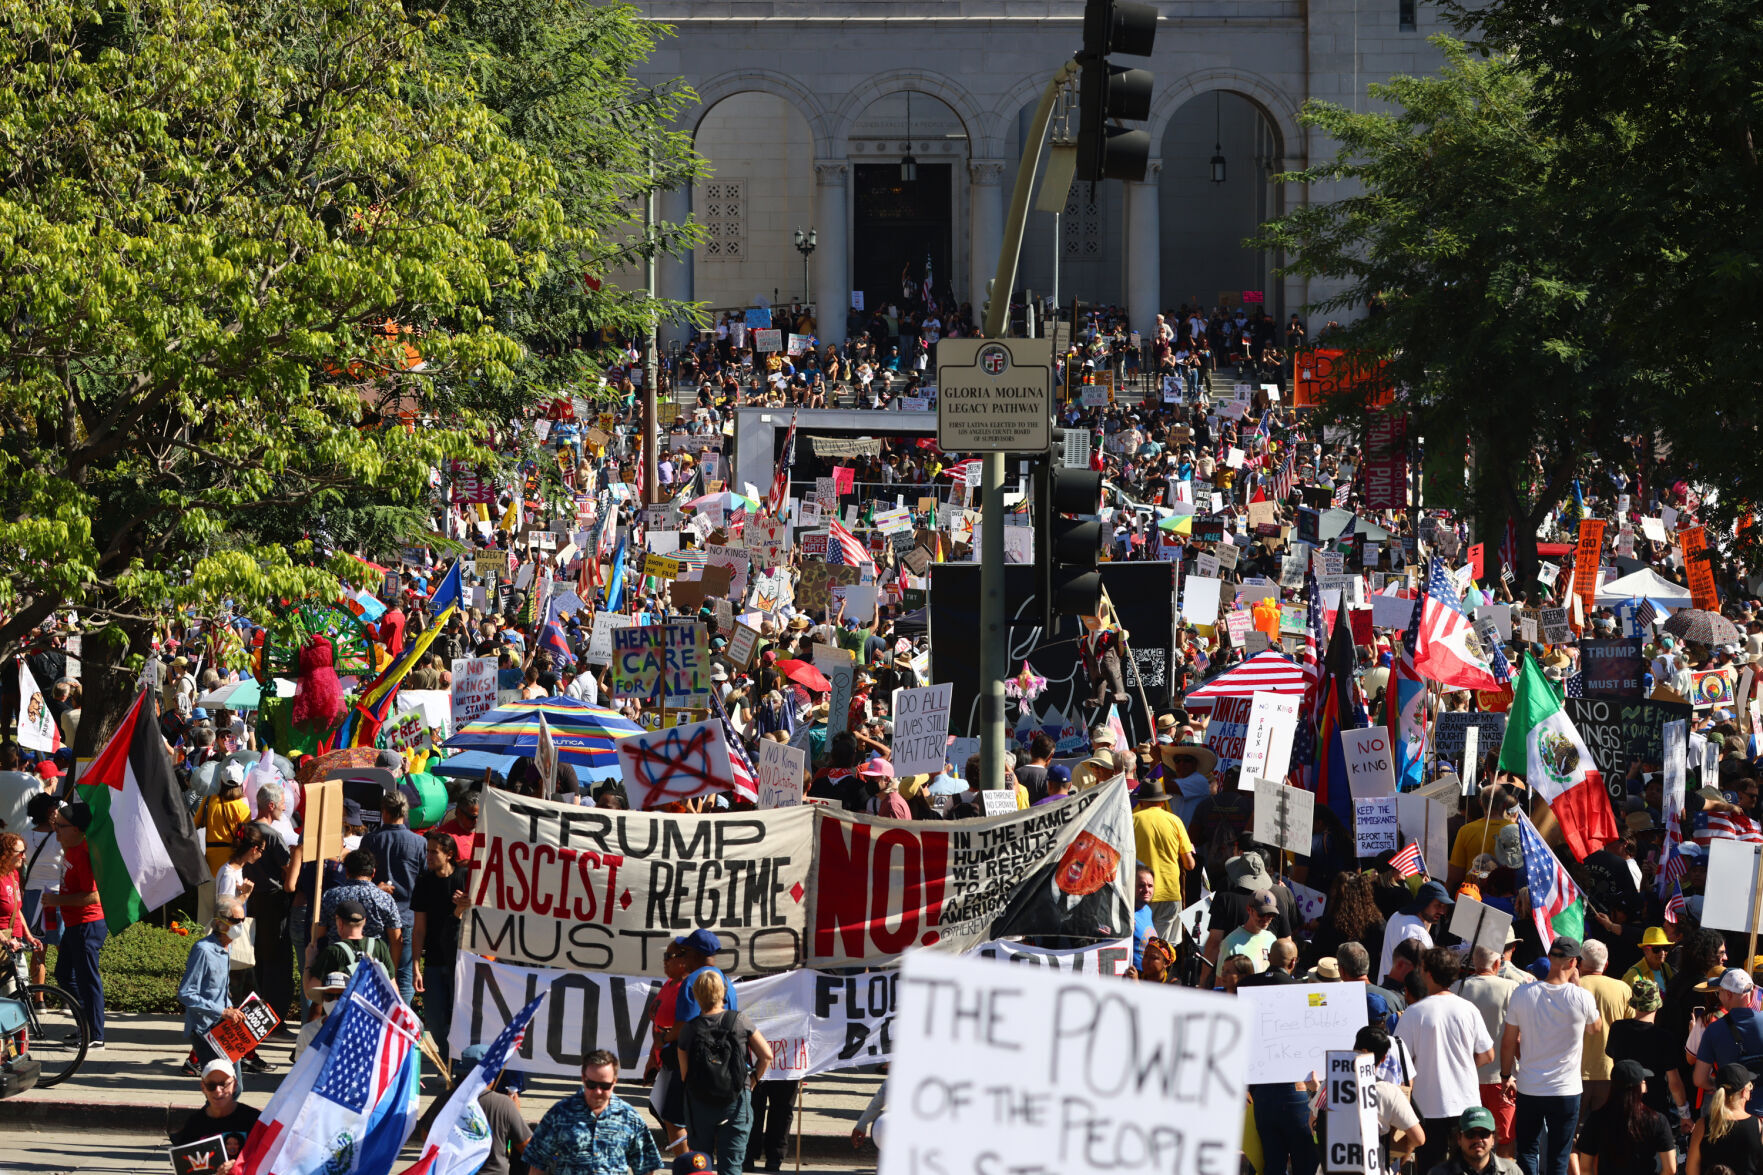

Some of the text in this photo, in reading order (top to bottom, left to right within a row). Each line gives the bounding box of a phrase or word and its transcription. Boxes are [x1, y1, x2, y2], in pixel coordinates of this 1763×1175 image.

[944, 387, 1043, 398] GLORIA MOLINA
[948, 403, 1040, 414] LEGACY PATHWAY
[1369, 467, 1391, 506] PARK
[579, 502, 590, 513] NO
[804, 544, 826, 553] HATE
[1581, 539, 1597, 548] GO
[477, 551, 505, 559] REJECT
[709, 546, 748, 559] NO KINGS
[647, 559, 676, 570] SHOW US
[487, 570, 496, 579] ICE
[661, 570, 677, 578] FILES
[1541, 608, 1566, 620] DEFEND
[614, 625, 695, 650] HEALTH
[1586, 646, 1636, 658] TRUMP
[622, 648, 698, 673] CARE
[467, 661, 484, 676] NO
[615, 671, 709, 697] FOR ALL
[1588, 680, 1638, 688] MUST BE
[456, 692, 497, 706] UNITED WE
[899, 689, 948, 715] DO ALL
[465, 703, 491, 714] STAND
[1575, 699, 1609, 721] NO
[927, 715, 947, 733] STILL
[1444, 713, 1494, 722] BOTH OF MY
[391, 719, 422, 743] FREE
[1219, 722, 1237, 737] ARE
[1435, 732, 1465, 740] FOUGHT
[1574, 721, 1620, 749] INGS
[1357, 738, 1385, 754] NO
[765, 745, 798, 776] NO Kings
[1352, 760, 1388, 774] KING
[1591, 746, 1625, 773] NCE
[759, 765, 798, 790] NO Dictators
[762, 787, 774, 806] NO
[984, 791, 1015, 800] NO THRONES
[995, 800, 1017, 808] CROWNS
[1357, 804, 1390, 815] KEEP THE
[953, 831, 971, 849] IN
[978, 825, 1017, 844] THE
[1023, 805, 1073, 831] NAME
[1357, 816, 1397, 825] IMMIGRANTS
[509, 803, 767, 859] TRUMP
[1357, 832, 1395, 841] DEPORT THE
[953, 829, 1058, 865] HUMANITY
[1361, 840, 1395, 850] RACISTS!
[952, 867, 979, 880] WE
[986, 839, 1058, 878] REFUSE
[467, 832, 792, 929] FASCIST REGIME
[814, 816, 949, 958] NO!
[953, 882, 979, 896] TO
[946, 899, 958, 911] A
[470, 908, 671, 971] MUST
[253, 1006, 265, 1019] Nov
[242, 1005, 262, 1028] FLOOD
[257, 1025, 268, 1037] DC
[1261, 1010, 1348, 1037] Free Bubbles
[221, 1023, 246, 1053] MUST GO
[907, 976, 1242, 1107] THE POWER
[1332, 1080, 1356, 1104] IS
[1362, 1084, 1377, 1109] IS
[909, 1078, 974, 1122] OF
[989, 1085, 1047, 1128] THE
[1060, 1096, 1228, 1169] PEOPLE
